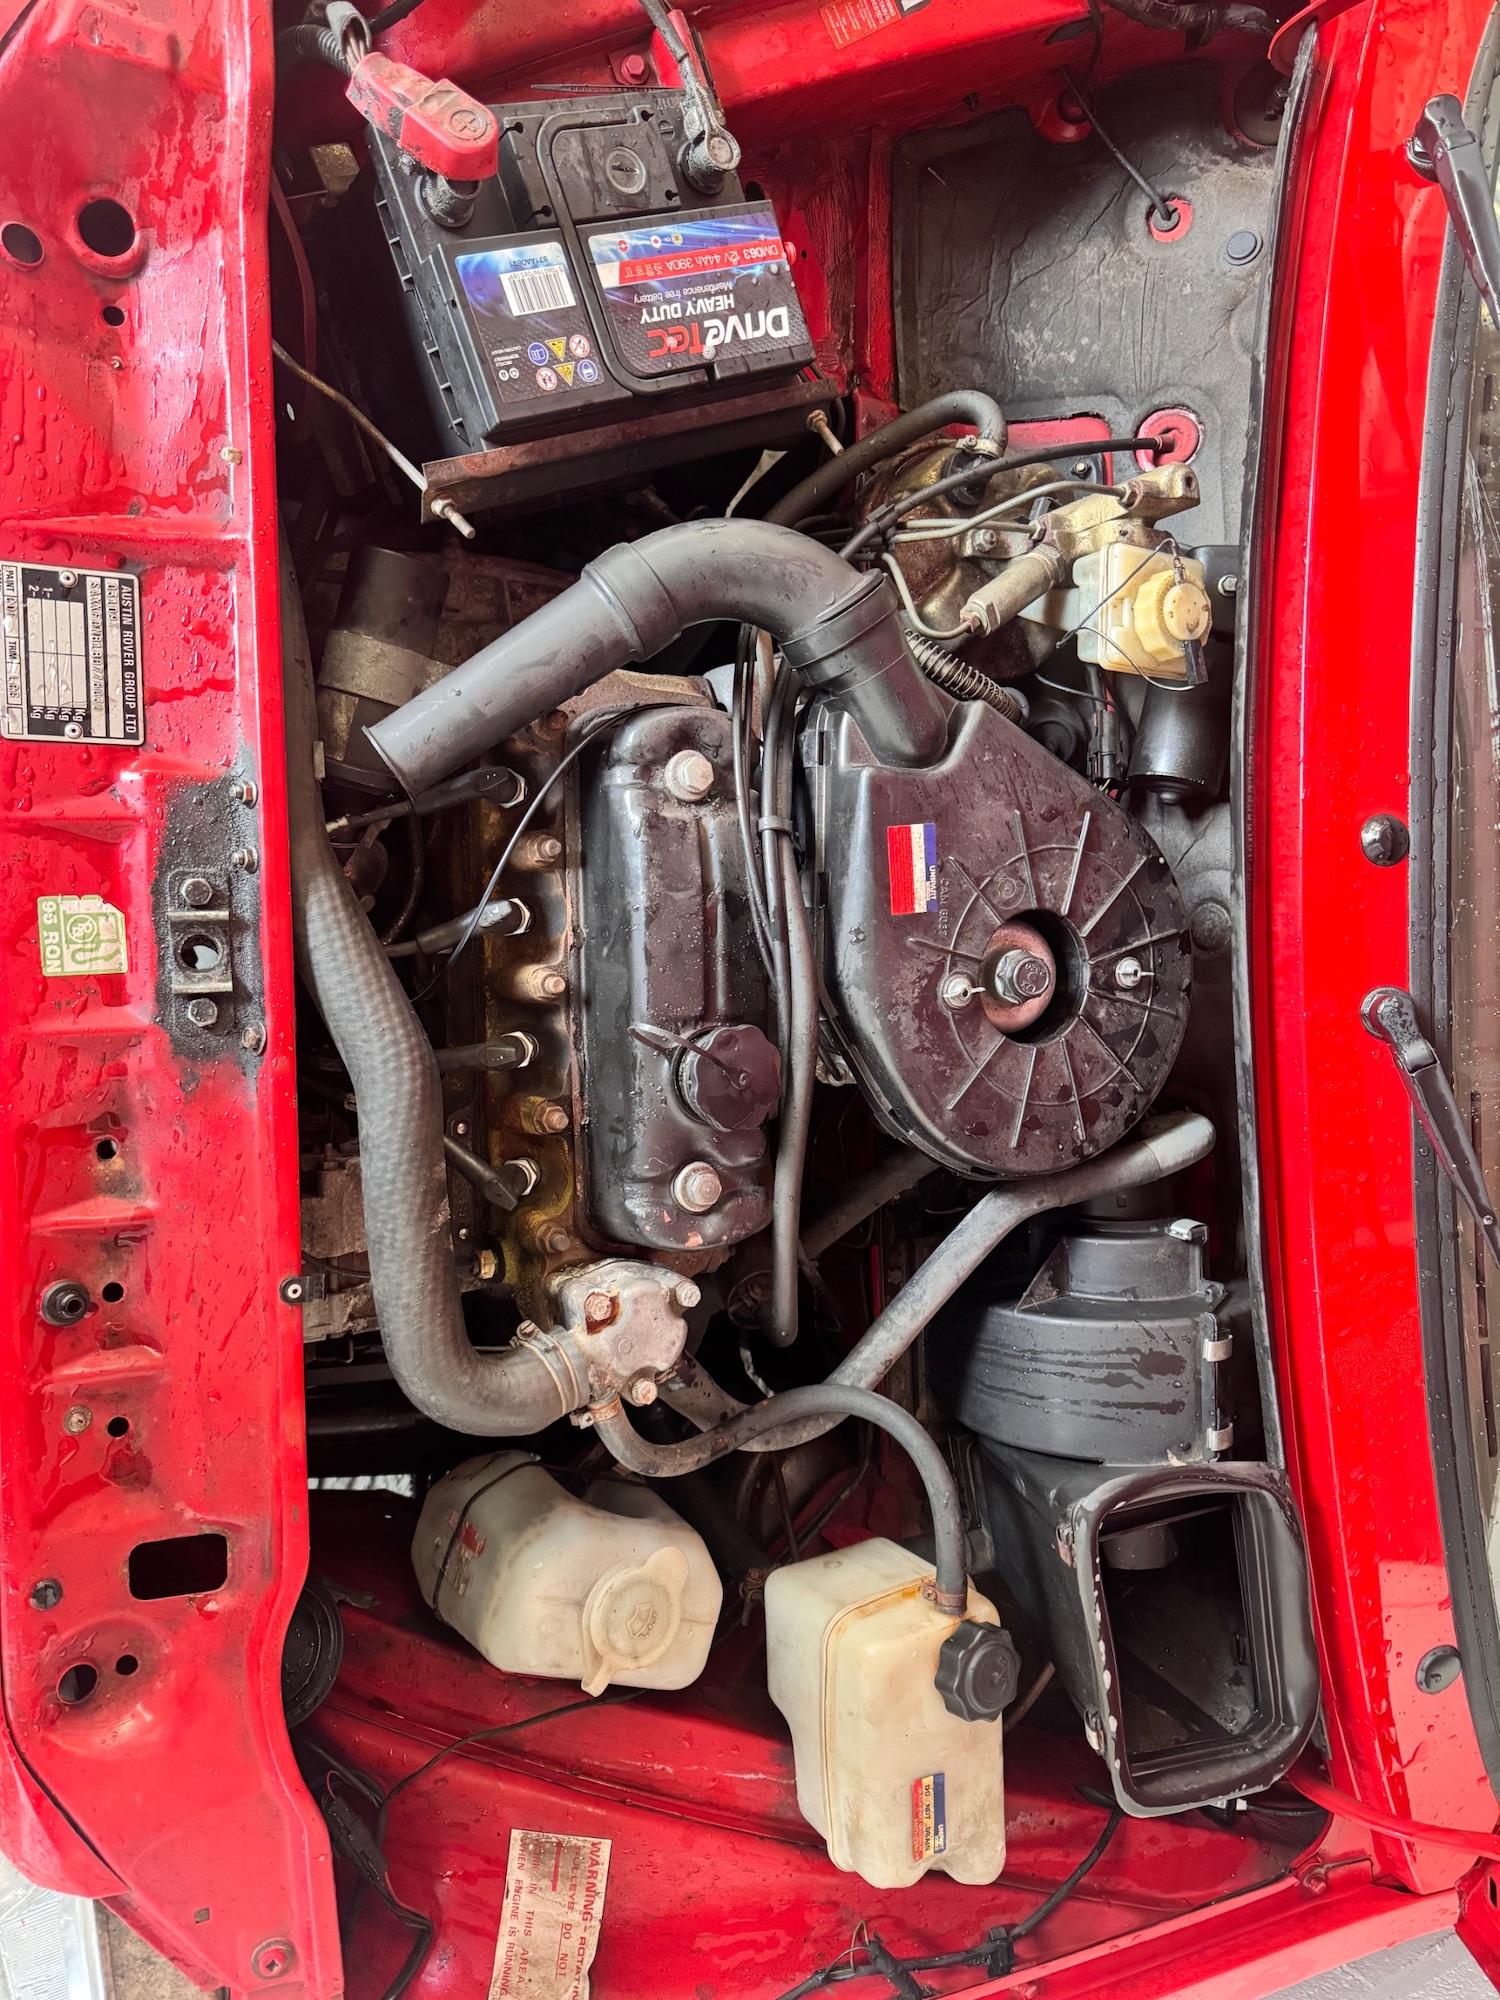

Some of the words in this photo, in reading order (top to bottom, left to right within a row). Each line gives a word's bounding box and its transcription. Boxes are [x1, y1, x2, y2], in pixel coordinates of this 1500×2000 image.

[694, 252, 722, 266] 44Ah
[723, 248, 741, 263] 12V
[743, 244, 779, 259] DM063
[665, 256, 693, 271] 390A
[665, 290, 681, 299] free
[683, 280, 733, 296] Maintenance
[634, 293, 663, 305] battery
[684, 294, 735, 316] HEAVY
[640, 303, 682, 324] DUTY
[5, 570, 15, 593] PAINT
[121, 585, 133, 626] AUSTIN
[8, 641, 17, 660] TRIM
[123, 630, 135, 666] ROVER
[124, 671, 136, 709] GROUP
[31, 706, 43, 719] Kg
[45, 706, 58, 720] Kg
[59, 707, 72, 721] Kg
[72, 708, 85, 722] Kg
[125, 713, 137, 734] LTD
[929, 865, 937, 900] UNIPART
[42, 900, 57, 925] 95
[44, 931, 62, 973] RON
[517, 1837, 527, 1871] WHEN
[532, 1838, 542, 1870] WORK
[528, 1883, 538, 1895] IN
[582, 1841, 601, 1922] WARNING
[510, 1879, 523, 1920] ENGINE
[508, 1926, 517, 1937] IS
[523, 1910, 535, 1937] THIS
[563, 1923, 573, 1940] DO
[517, 1947, 529, 1984] AREA
[558, 1953, 568, 1979] NOT
